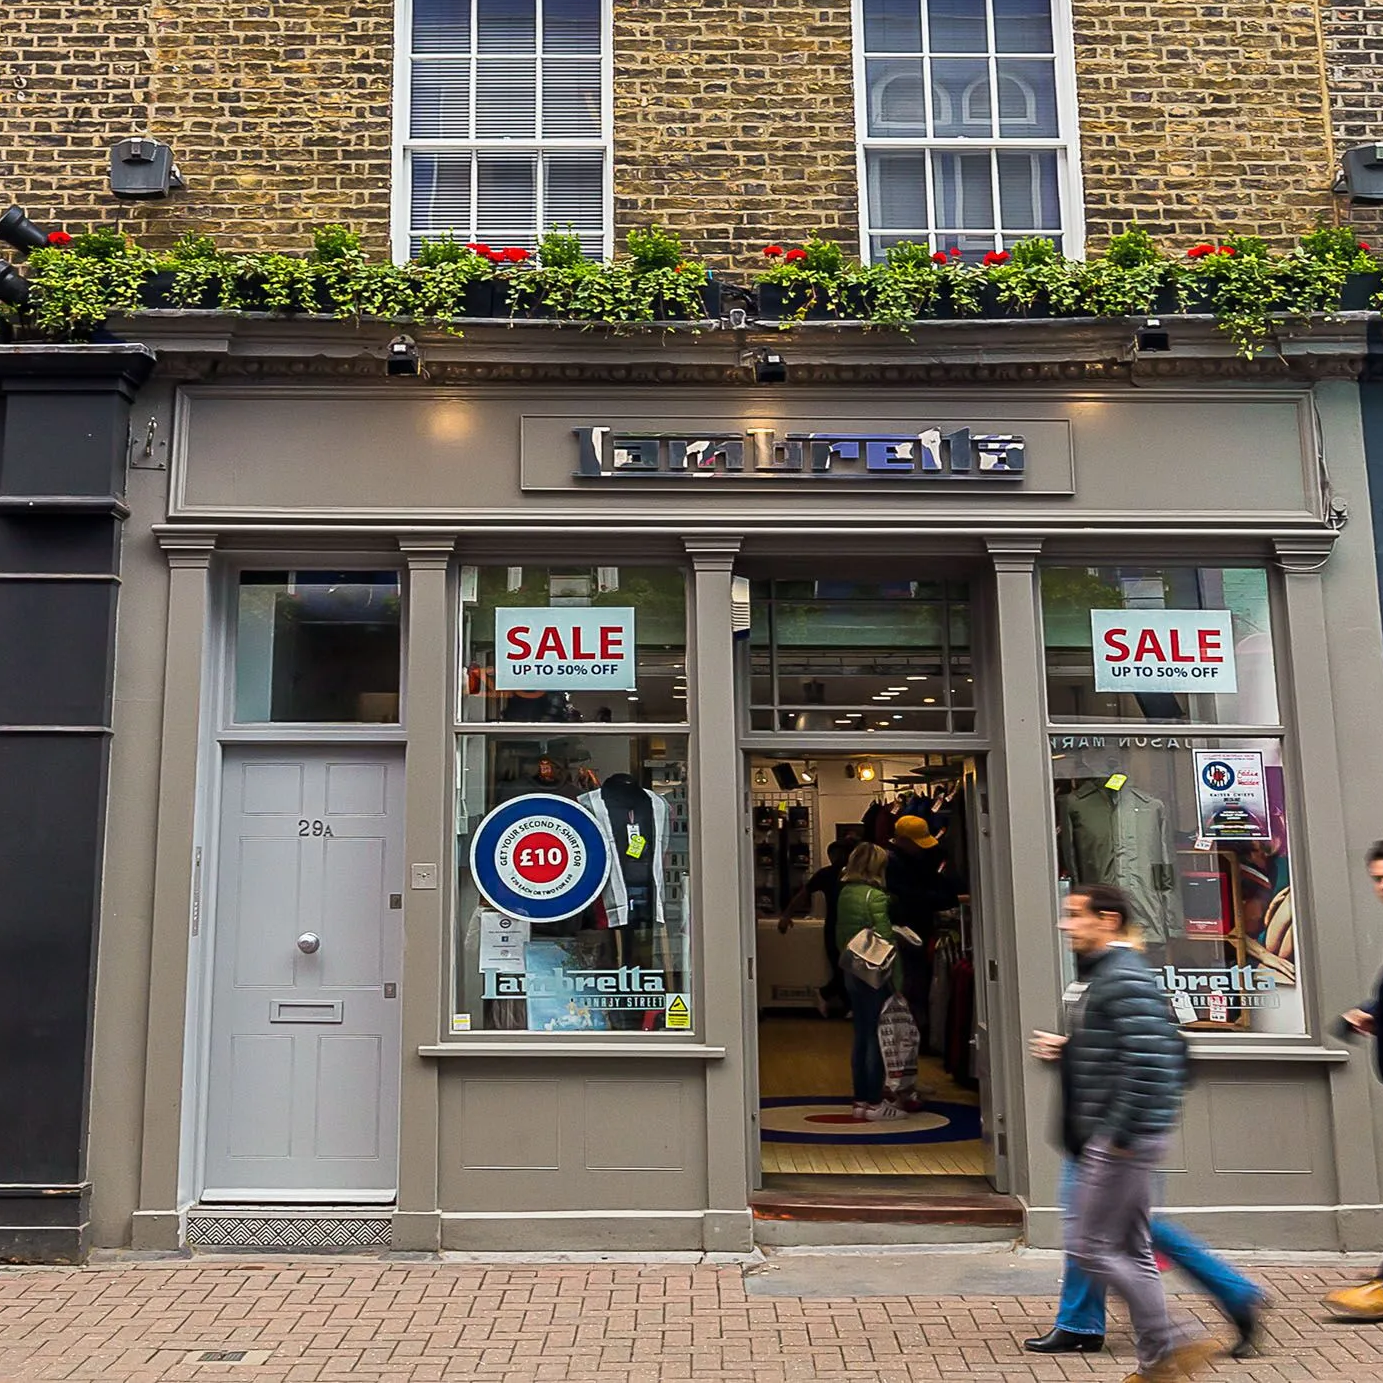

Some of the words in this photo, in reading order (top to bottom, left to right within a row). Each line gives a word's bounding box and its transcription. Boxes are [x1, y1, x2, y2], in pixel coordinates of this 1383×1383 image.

[506, 626, 624, 660] SALE
[1104, 628, 1224, 662] SALE
[512, 665, 531, 675] UP
[534, 665, 553, 675] TO
[557, 665, 588, 675] 50%
[591, 665, 618, 675] OFF
[1112, 666, 1131, 677] UP
[1134, 666, 1153, 677] TO
[1157, 667, 1188, 677] 50%
[1191, 667, 1218, 678] OFF
[298, 819, 334, 837] 29A
[518, 820, 554, 832] SECOND
[502, 829, 519, 850] YOUR
[555, 824, 580, 849] T-SHIRT
[500, 850, 508, 866] GET
[519, 847, 562, 867] £10
[573, 850, 582, 867] FOR
[626, 997, 664, 1008] STREET
